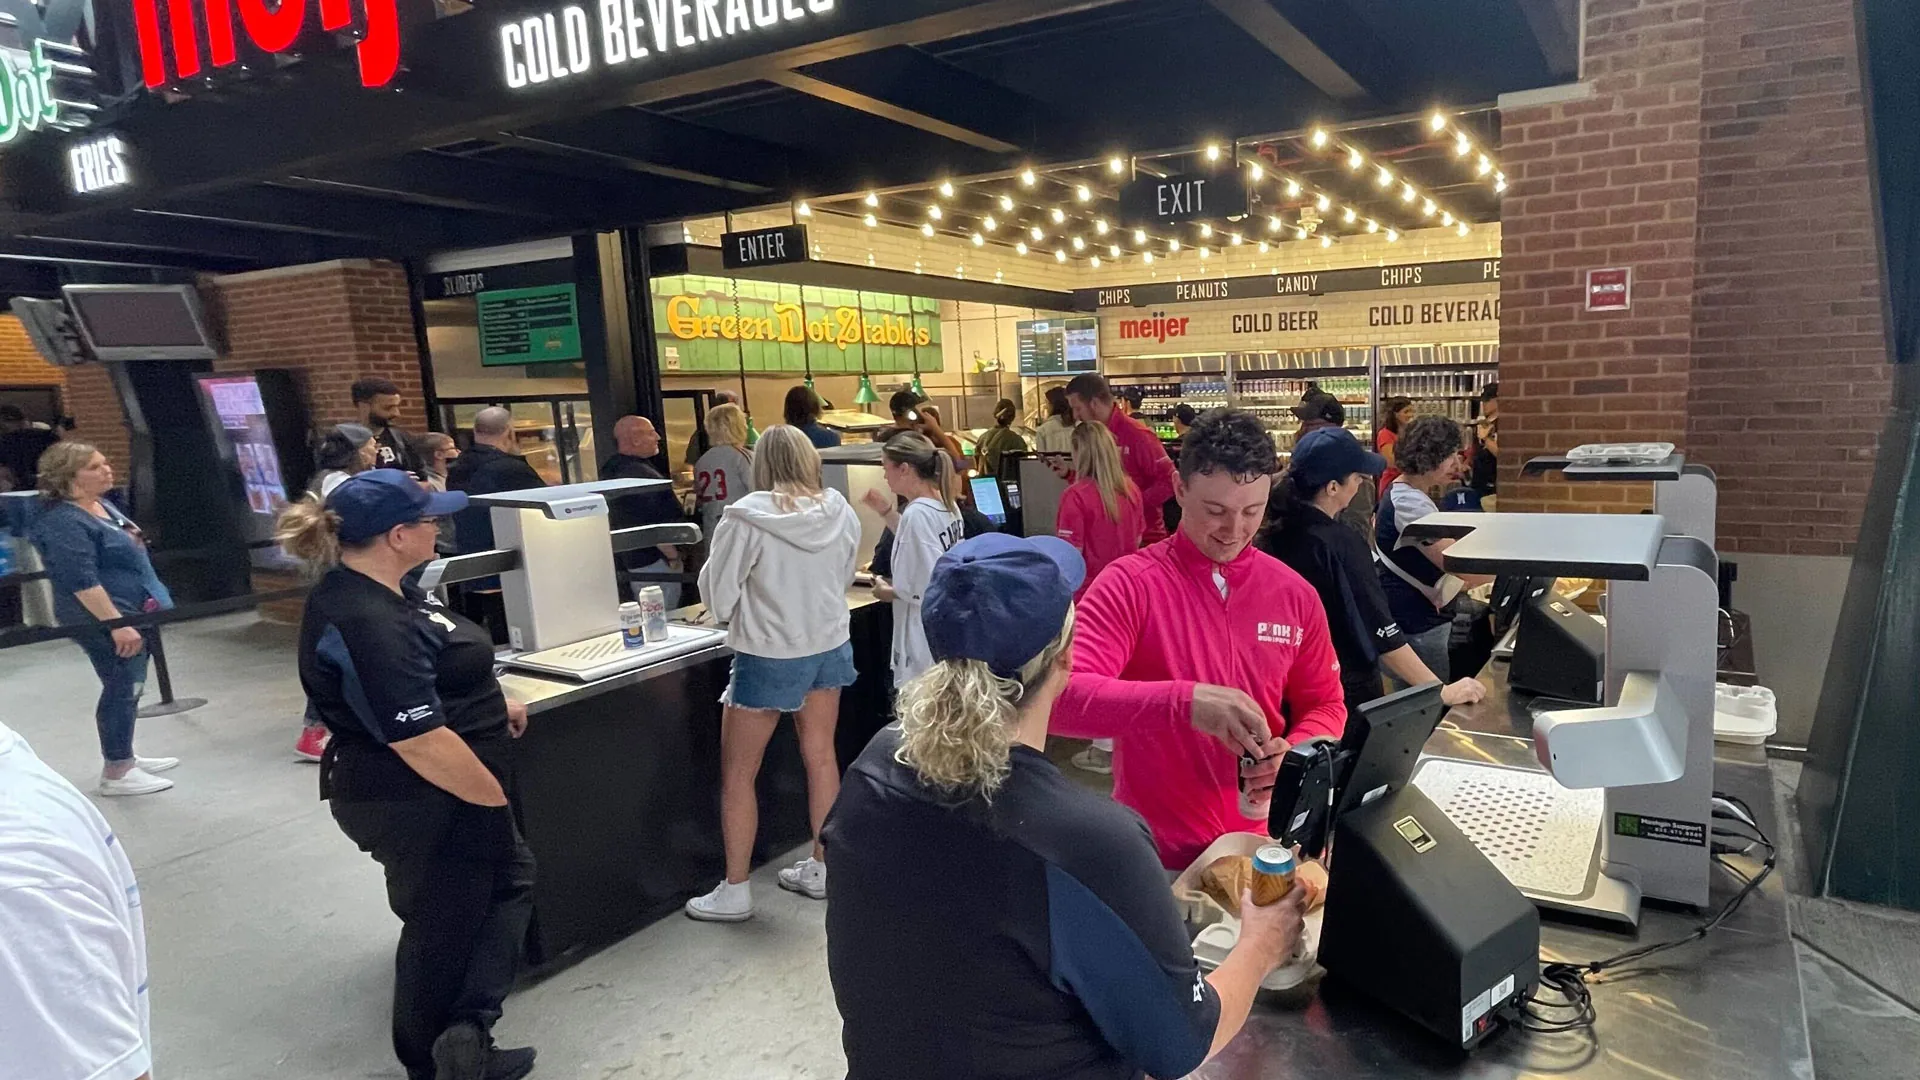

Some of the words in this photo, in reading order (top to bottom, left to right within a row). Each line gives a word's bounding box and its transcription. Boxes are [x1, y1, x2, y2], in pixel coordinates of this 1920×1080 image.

[500, 5, 591, 89] COLD
[600, 0, 837, 65] BEVERA
[70, 136, 127, 193] FRIES
[1157, 180, 1205, 216] EXIT
[738, 232, 786, 262] ENTER
[443, 273, 485, 295] SLIDERS
[1099, 288, 1130, 305] CHIPS
[1176, 281, 1228, 300] PEANUTS
[1277, 274, 1318, 293] CANDY
[1381, 266, 1422, 286] CHIPS
[666, 295, 775, 341] Green
[773, 302, 836, 344] Dot
[834, 306, 931, 351] Stables
[1119, 311, 1189, 343] meijer
[1232, 313, 1272, 333] COLD
[1278, 310, 1318, 331] BEER
[1369, 304, 1414, 327] COLD
[1421, 299, 1500, 324] BEVERA
[696, 468, 728, 502] 23
